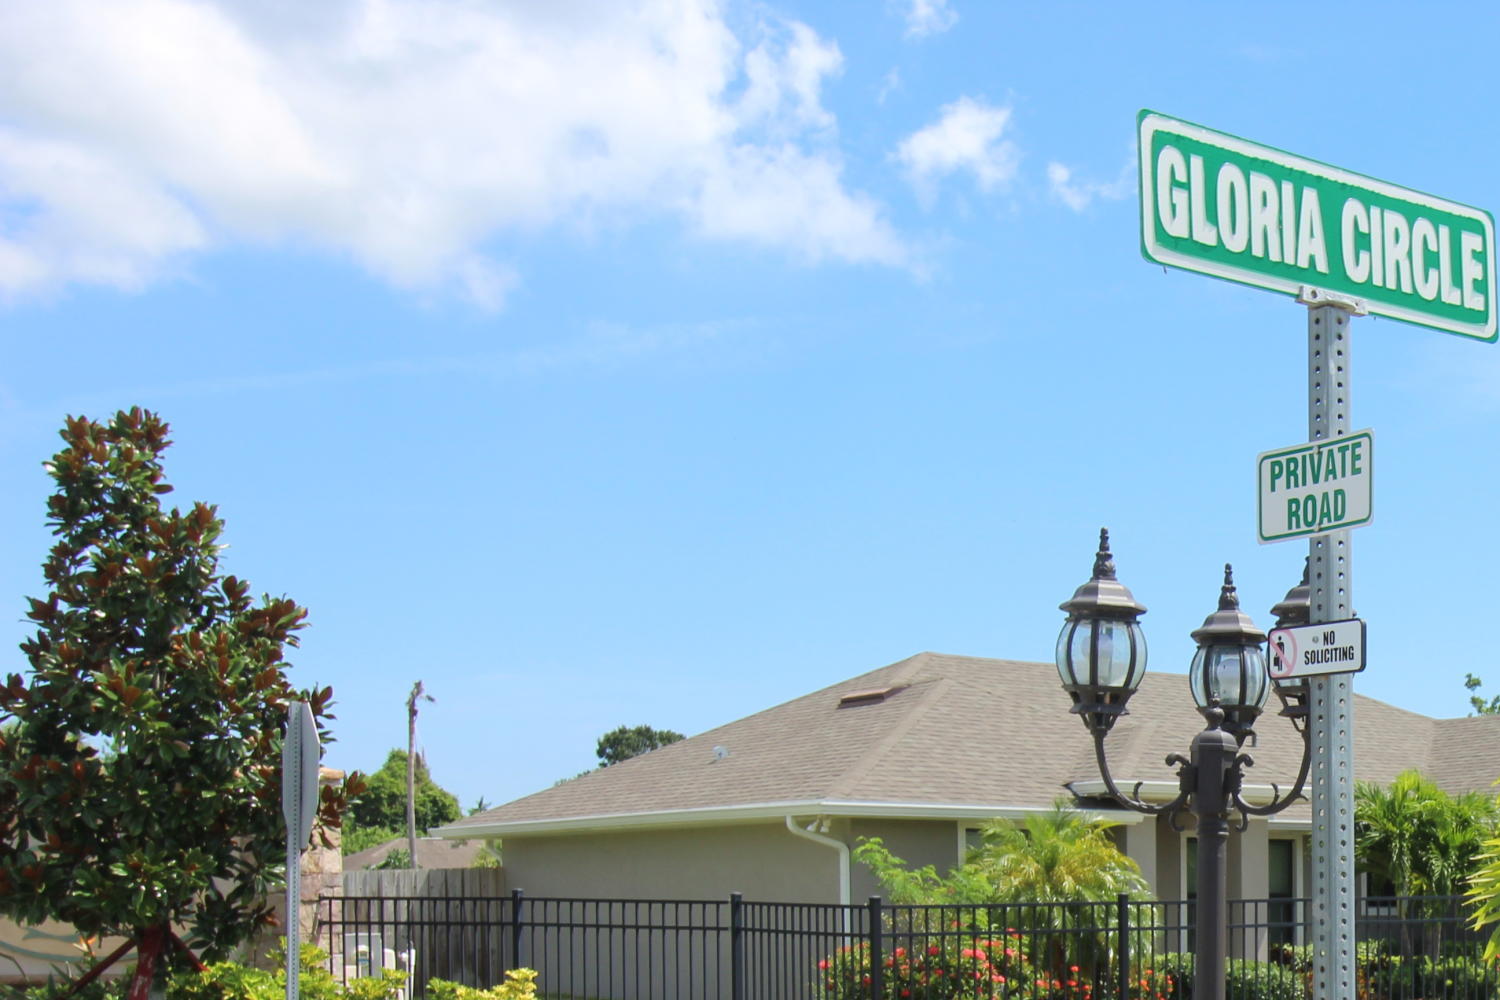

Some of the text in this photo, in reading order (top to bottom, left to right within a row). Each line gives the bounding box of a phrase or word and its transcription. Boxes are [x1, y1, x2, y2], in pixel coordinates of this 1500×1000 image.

[1157, 145, 1486, 311] GLORIA CIRCLE
[1270, 441, 1362, 492] PRIVATE
[1287, 489, 1346, 531] ROAD
[1304, 646, 1355, 666] SOLICITING
[1323, 630, 1335, 647] NO
